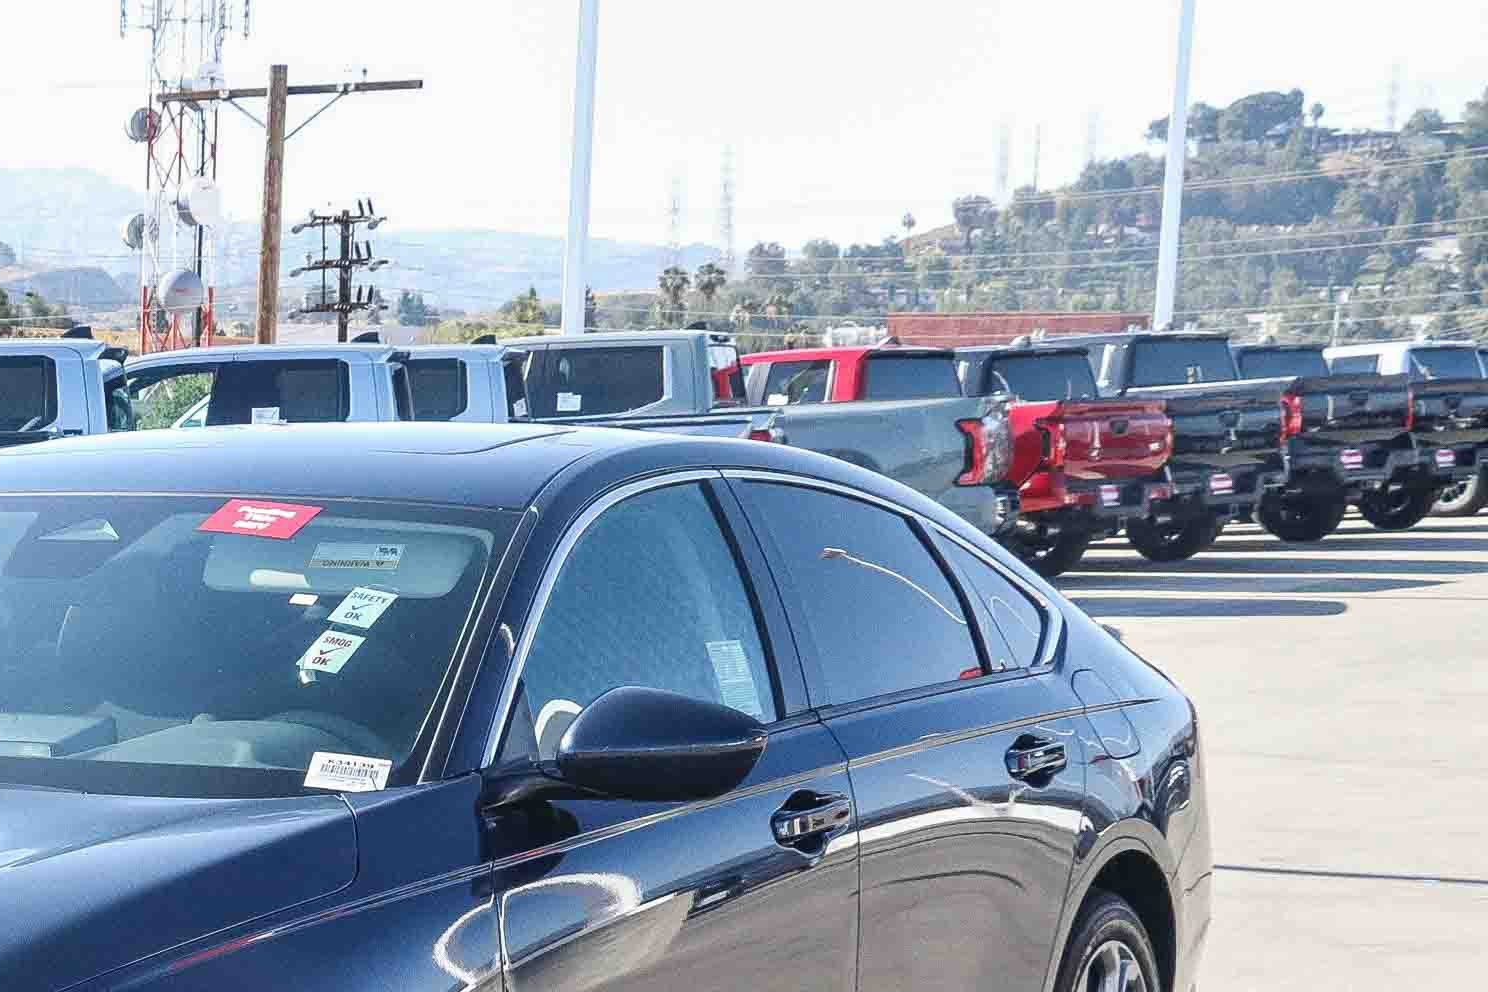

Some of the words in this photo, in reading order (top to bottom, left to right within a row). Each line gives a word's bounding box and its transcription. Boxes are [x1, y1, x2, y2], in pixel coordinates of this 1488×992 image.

[350, 590, 389, 606] SAFETY
[344, 611, 362, 622] OK
[321, 635, 353, 648] SMOG
[311, 656, 332, 667] OK
